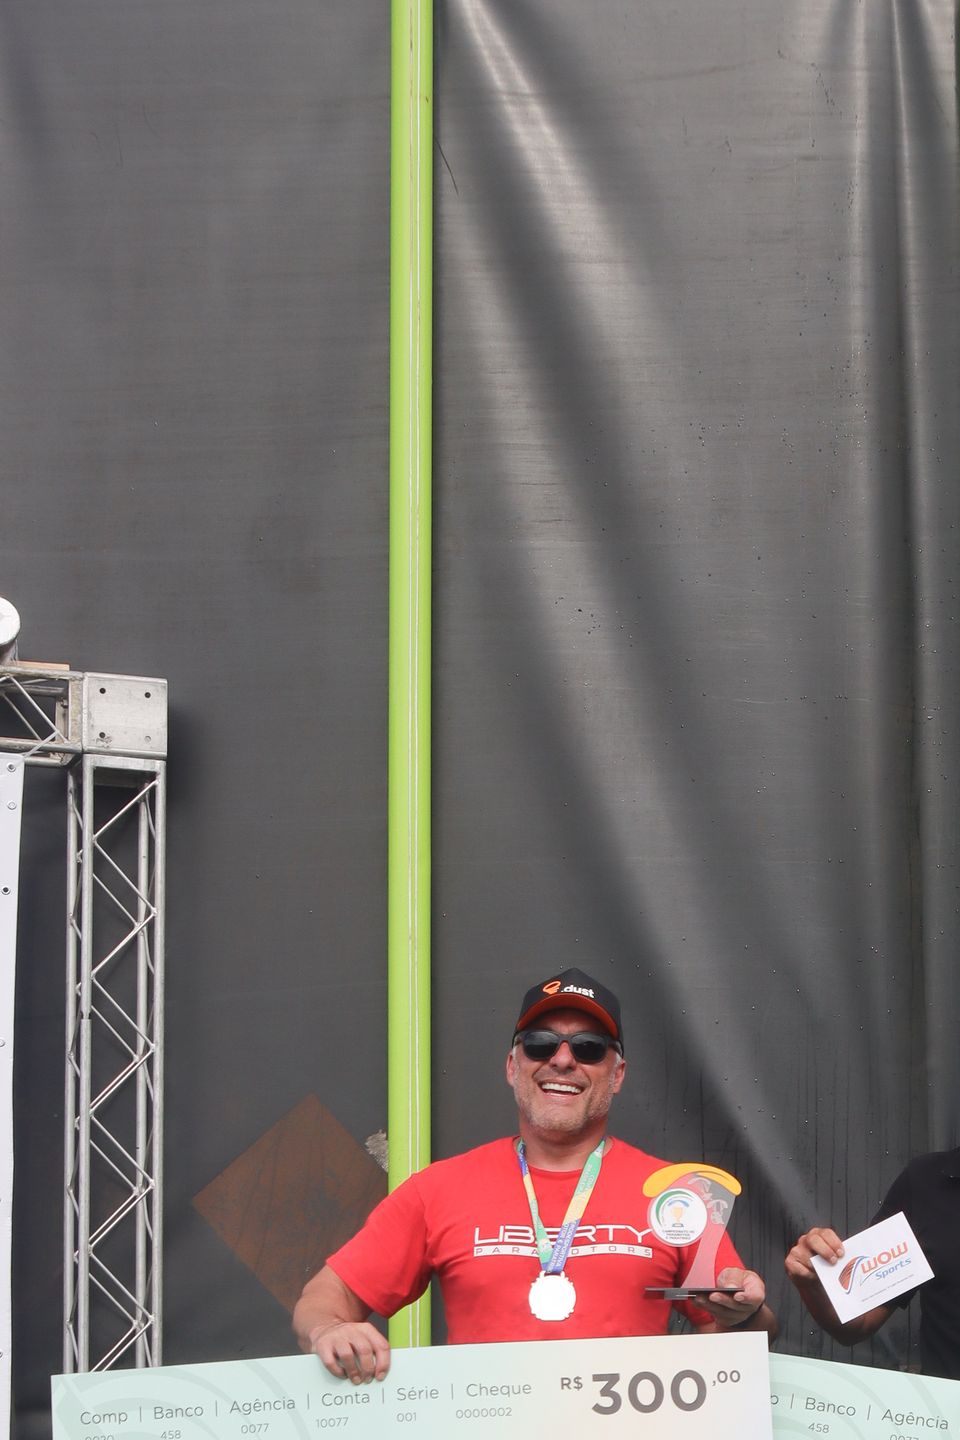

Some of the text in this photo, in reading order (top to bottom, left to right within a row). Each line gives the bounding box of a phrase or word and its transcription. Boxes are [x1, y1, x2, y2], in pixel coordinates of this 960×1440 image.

[475, 1245, 652, 1256] PARAOTORS
[875, 1257, 911, 1280] Sports
[560, 1375, 584, 1391] R$
[80, 1382, 533, 1427] Comp Banco Agência Conta Série Cheque
[803, 1395, 856, 1417] Banco
[880, 1407, 949, 1432] Agência
[160, 1429, 183, 1440] 458
[240, 1423, 270, 1435] 0077
[315, 1417, 349, 1429] 10077
[396, 1412, 418, 1424] 001
[455, 1406, 513, 1420] 0000002
[807, 1422, 831, 1435] 458
